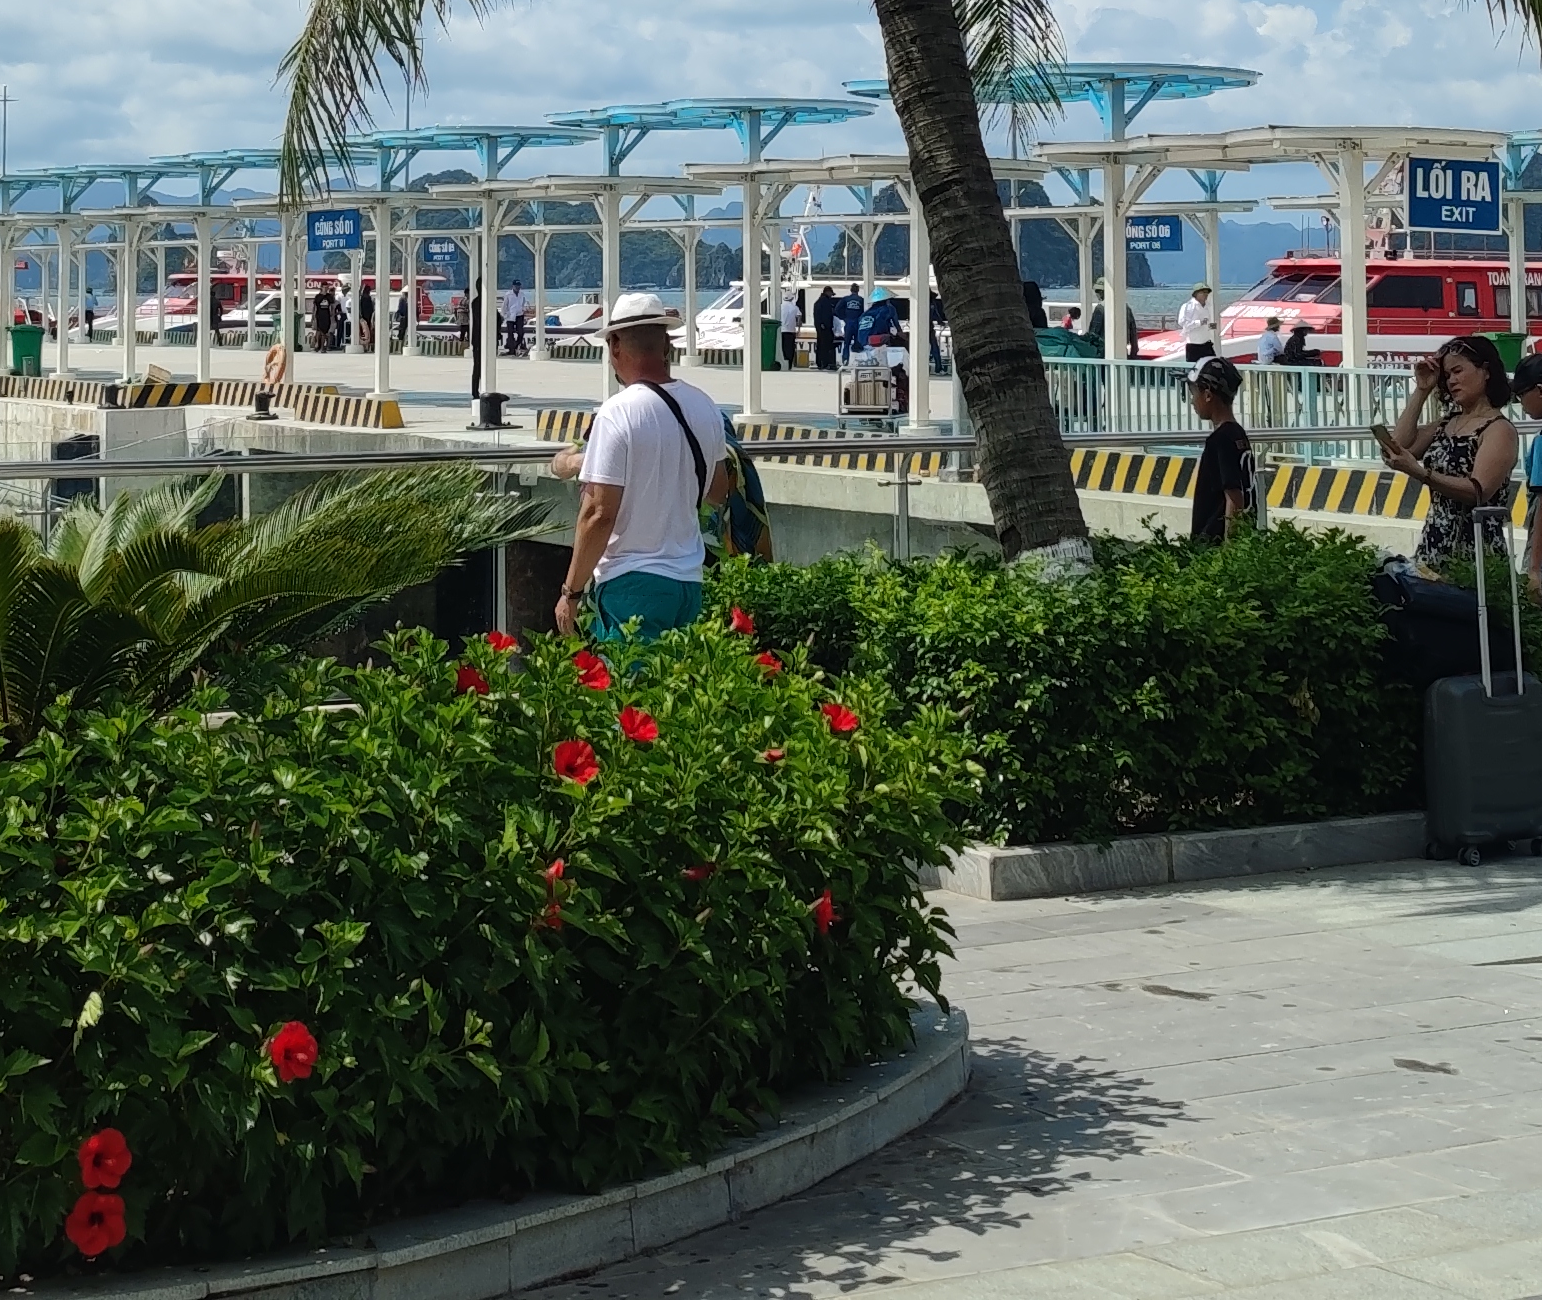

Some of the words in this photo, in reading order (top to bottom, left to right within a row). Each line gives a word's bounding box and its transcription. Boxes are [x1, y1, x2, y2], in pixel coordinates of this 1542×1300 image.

[1416, 161, 1453, 200] LỐI
[1461, 171, 1492, 202] RA
[1441, 205, 1476, 223] EXIT
[335, 215, 344, 235] SỐ
[345, 220, 353, 235] 01
[1126, 219, 1145, 238] ỔNG
[1145, 219, 1158, 238] SỐ
[322, 239, 337, 249] PORT
[1130, 241, 1150, 249] PORT
